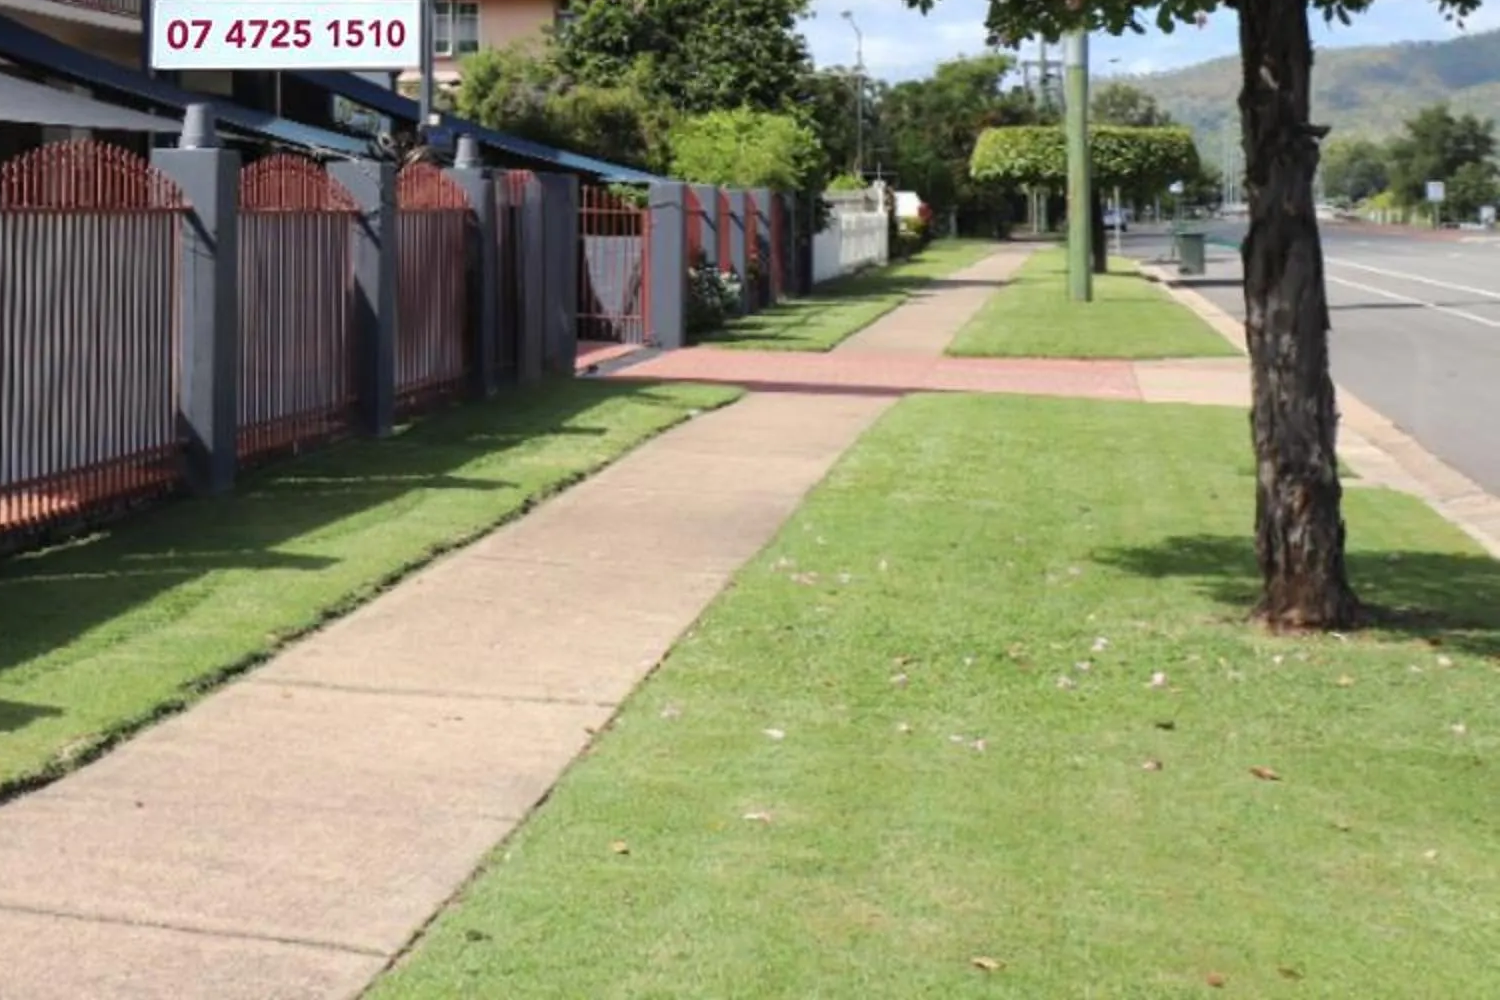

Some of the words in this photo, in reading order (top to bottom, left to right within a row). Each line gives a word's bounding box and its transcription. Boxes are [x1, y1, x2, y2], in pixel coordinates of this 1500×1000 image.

[167, 19, 213, 50] 07
[224, 19, 312, 49] 4725
[326, 19, 406, 48] 1510
